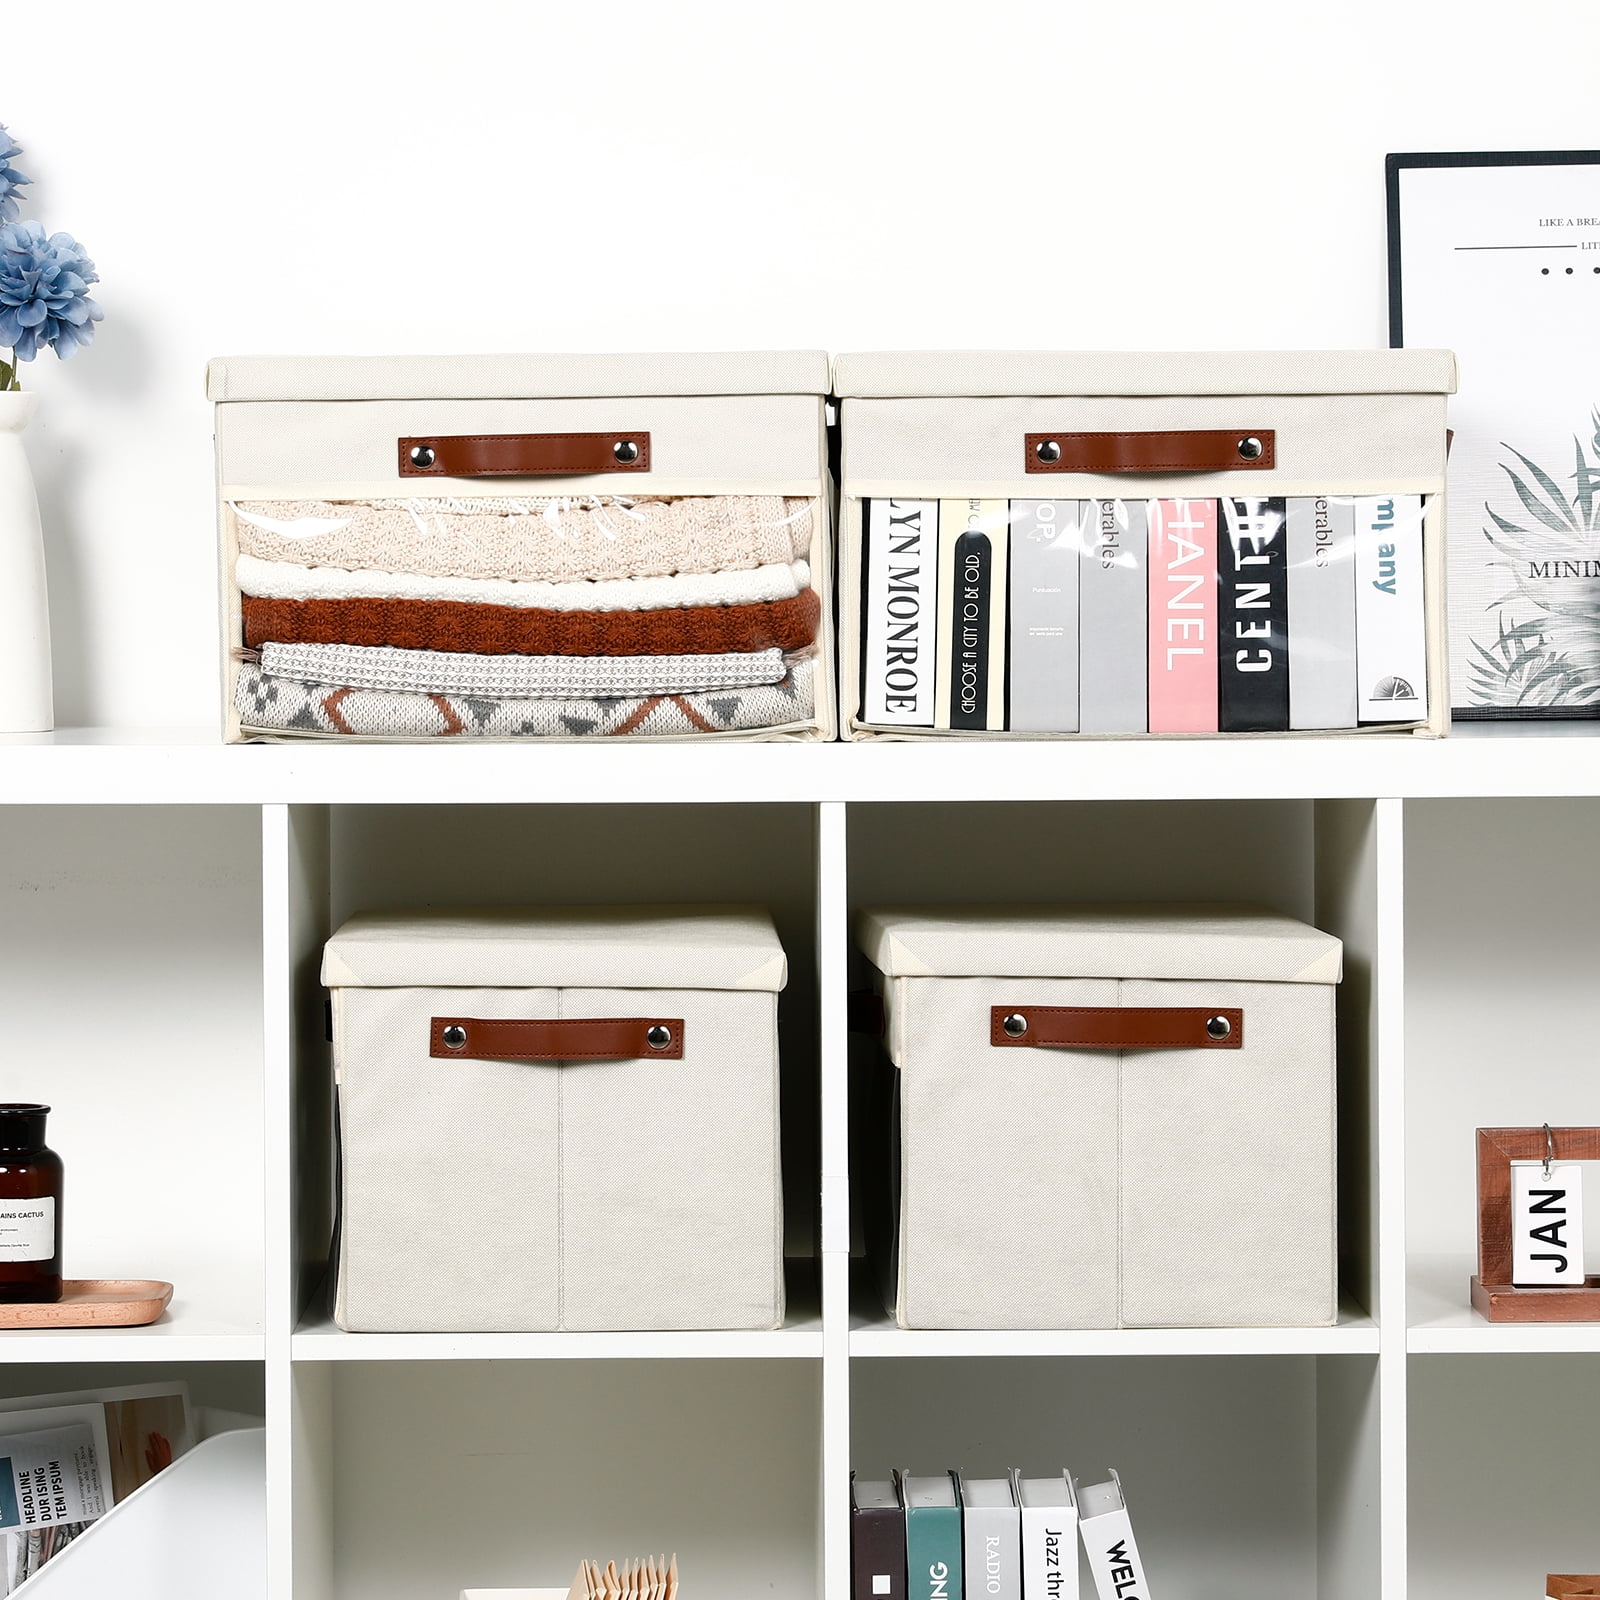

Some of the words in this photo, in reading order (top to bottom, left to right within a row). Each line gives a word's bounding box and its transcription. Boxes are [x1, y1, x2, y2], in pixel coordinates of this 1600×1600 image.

[1539, 218, 1564, 227] LIKE
[1566, 218, 1574, 226] A
[1576, 217, 1600, 226] BRE
[1581, 241, 1600, 250] LIT
[1315, 496, 1334, 568] erables
[964, 587, 980, 599] BE
[963, 602, 979, 623] TO
[884, 564, 921, 714] MONROE
[962, 627, 977, 647] CITY
[961, 662, 977, 714] CHOOSE
[1528, 1189, 1568, 1273] JAN
[34, 1467, 49, 1496] ISING
[48, 1460, 65, 1495] IPSUM
[19, 1471, 36, 1524] HEADLINE
[38, 1497, 52, 1522] DUR
[52, 1496, 68, 1520] TEM
[1045, 1528, 1062, 1567] Jazz
[985, 1535, 1001, 1595] RADIO
[1047, 1571, 1064, 1600] thr
